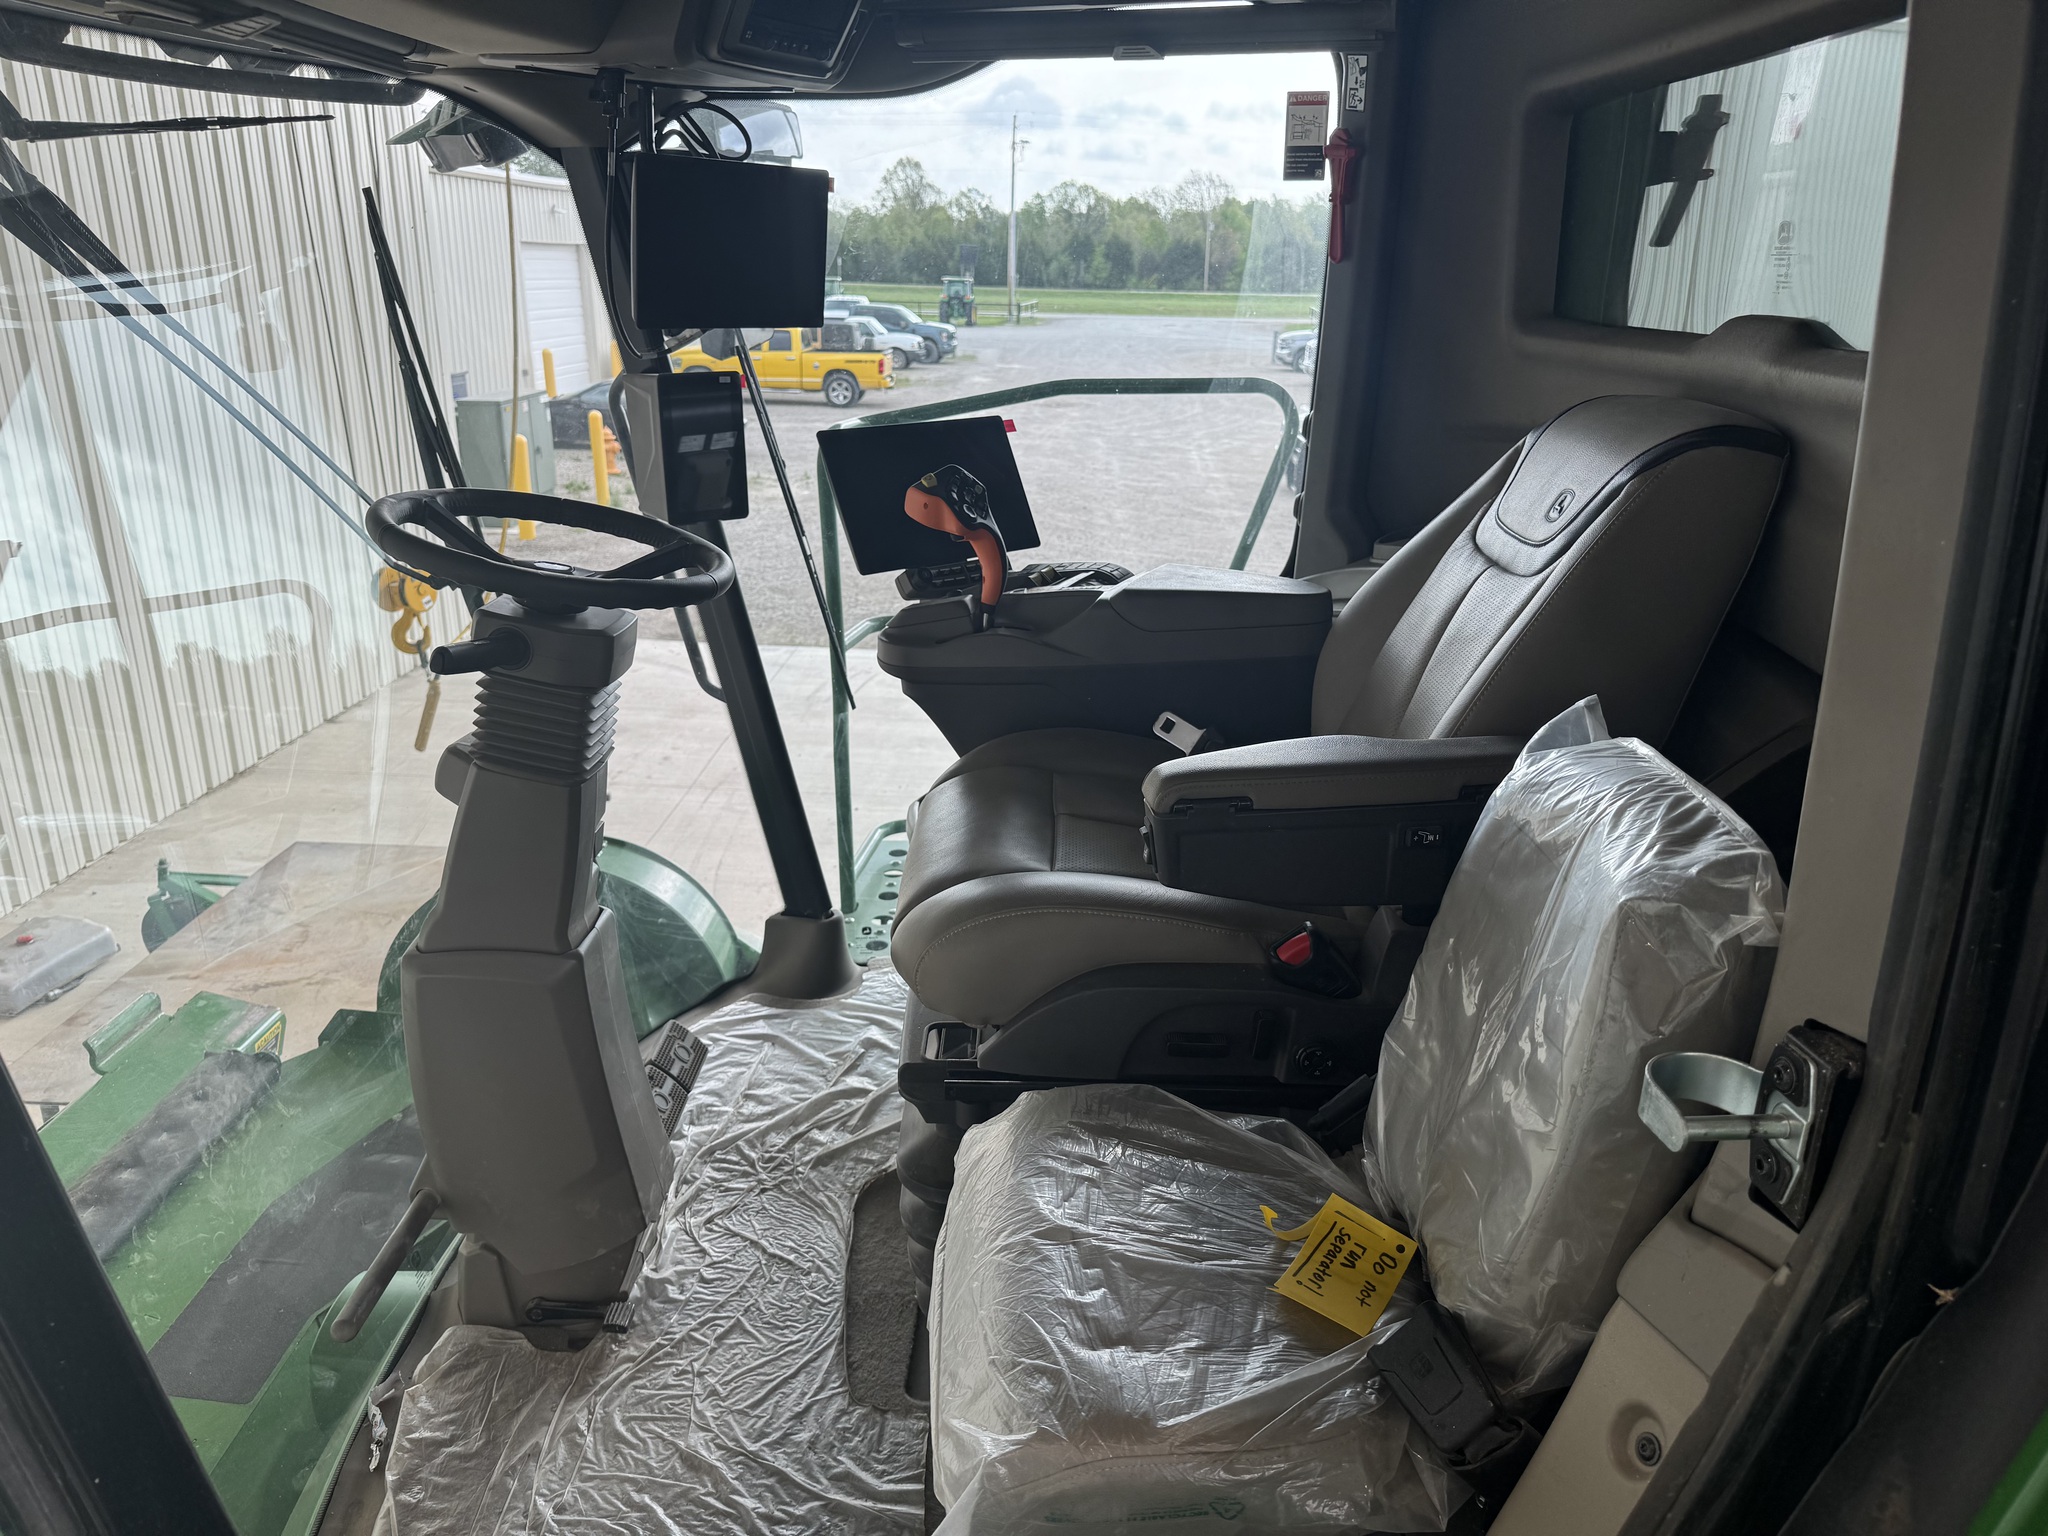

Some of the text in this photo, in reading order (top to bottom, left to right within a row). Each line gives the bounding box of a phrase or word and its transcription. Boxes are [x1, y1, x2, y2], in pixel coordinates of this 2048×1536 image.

[1297, 94, 1328, 102] DANGER
[1340, 1242, 1367, 1269] run
[1355, 1252, 1398, 1307] Do not
